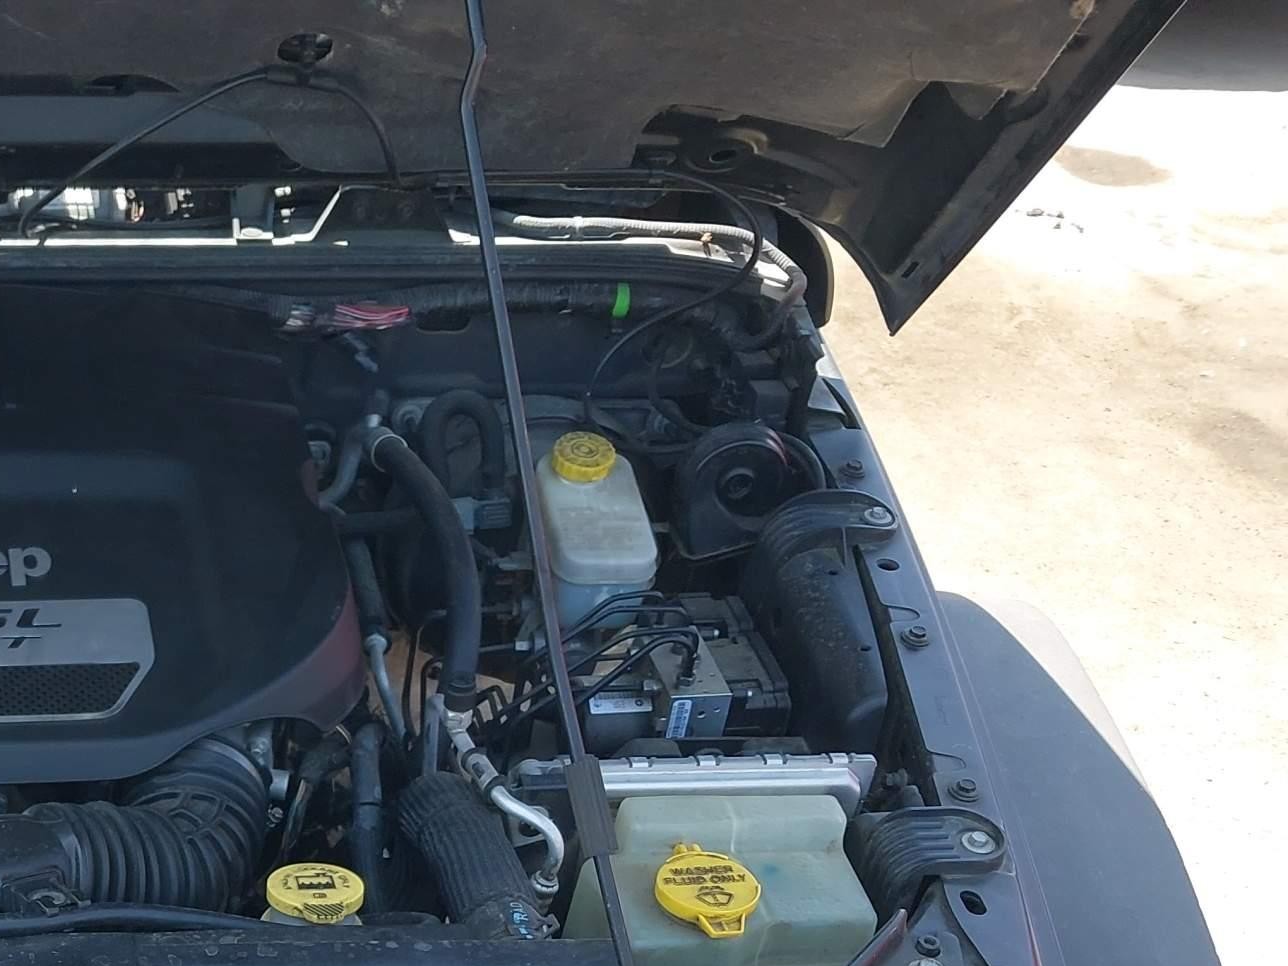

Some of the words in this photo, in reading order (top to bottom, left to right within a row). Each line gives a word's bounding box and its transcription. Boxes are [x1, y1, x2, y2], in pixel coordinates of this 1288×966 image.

[669, 865, 733, 876] WASHER
[663, 875, 706, 886] FLUID
[709, 873, 747, 884] ONLY
